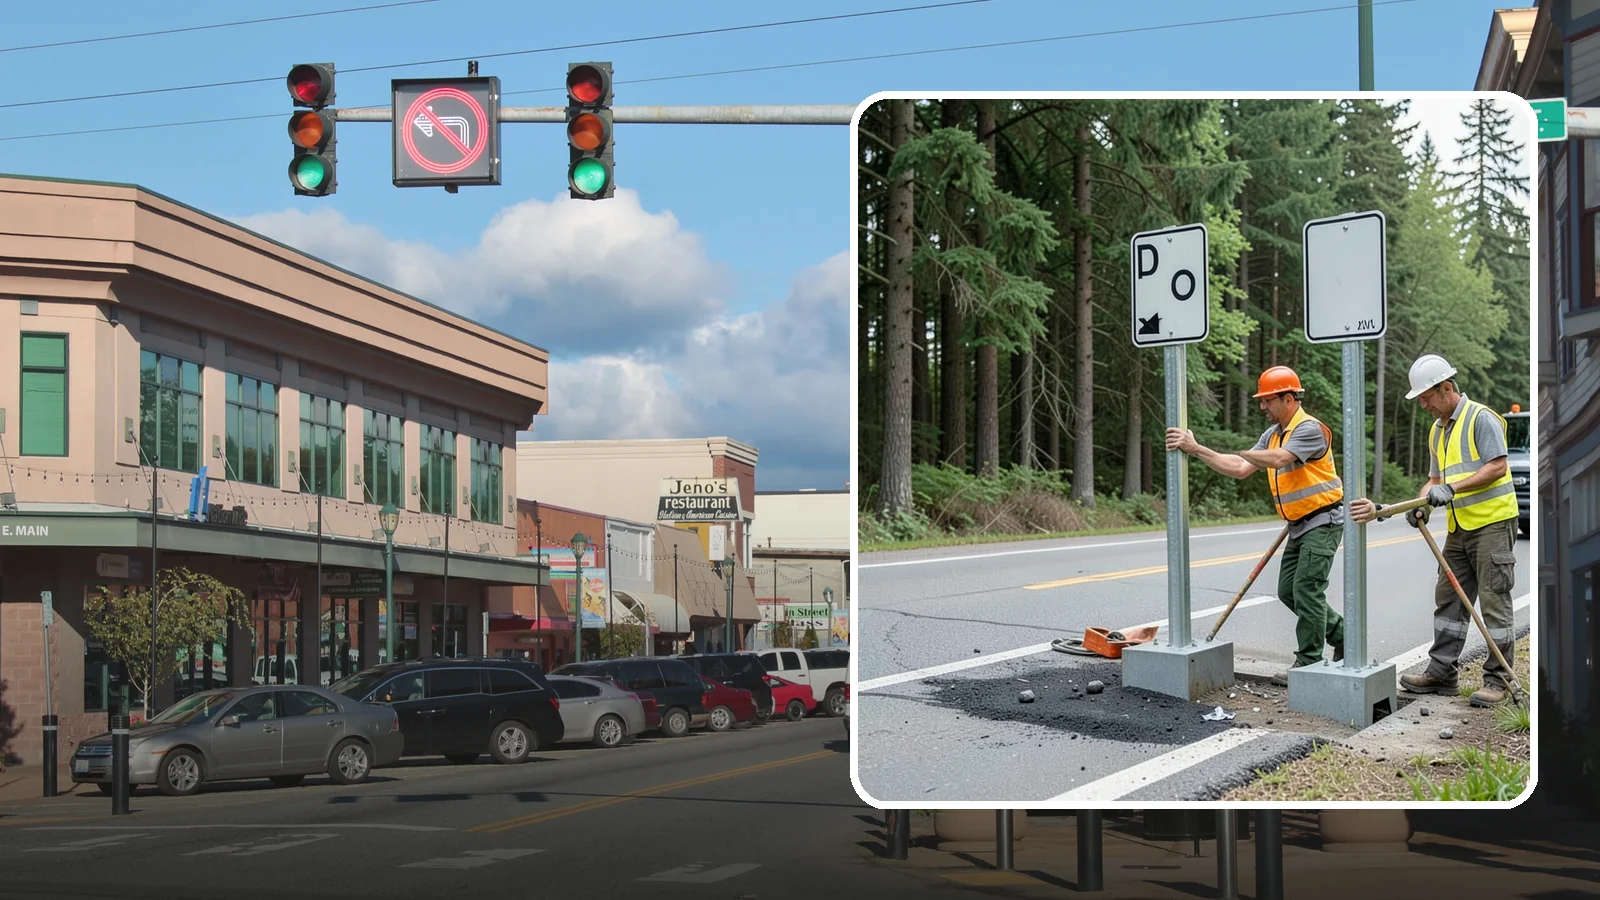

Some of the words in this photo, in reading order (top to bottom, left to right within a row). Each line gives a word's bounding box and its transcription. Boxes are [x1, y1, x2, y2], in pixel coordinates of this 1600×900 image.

[669, 480, 728, 494] Jeno's
[665, 496, 731, 509] restaurant
[685, 509, 714, 519] American
[714, 509, 738, 519] Cuisine
[2, 525, 13, 536] E.
[15, 525, 49, 536] MAIN
[785, 607, 795, 617] in
[797, 607, 829, 617] Street
[790, 619, 824, 627] lass
